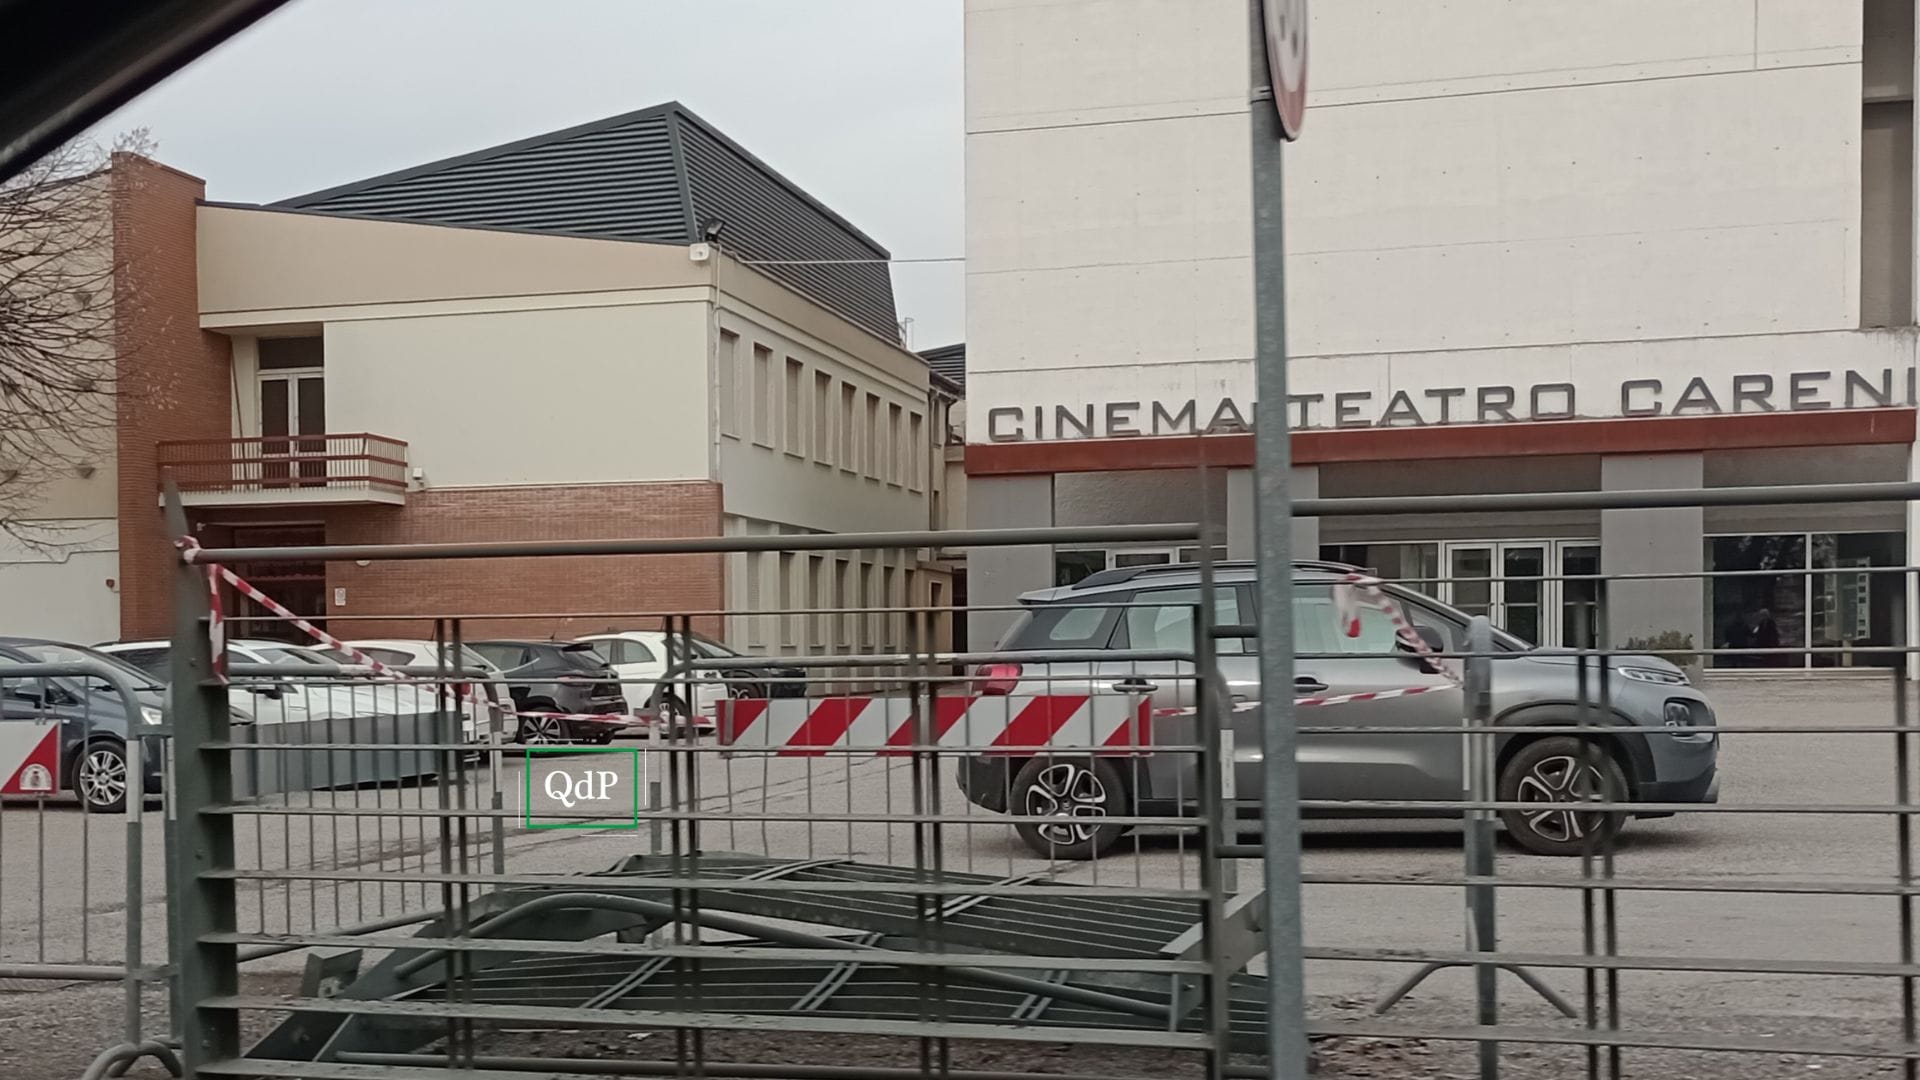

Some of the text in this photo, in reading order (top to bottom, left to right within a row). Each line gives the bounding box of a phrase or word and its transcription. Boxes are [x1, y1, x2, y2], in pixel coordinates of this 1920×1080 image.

[988, 367, 1916, 442] CINEMA TEATRO CARENI
